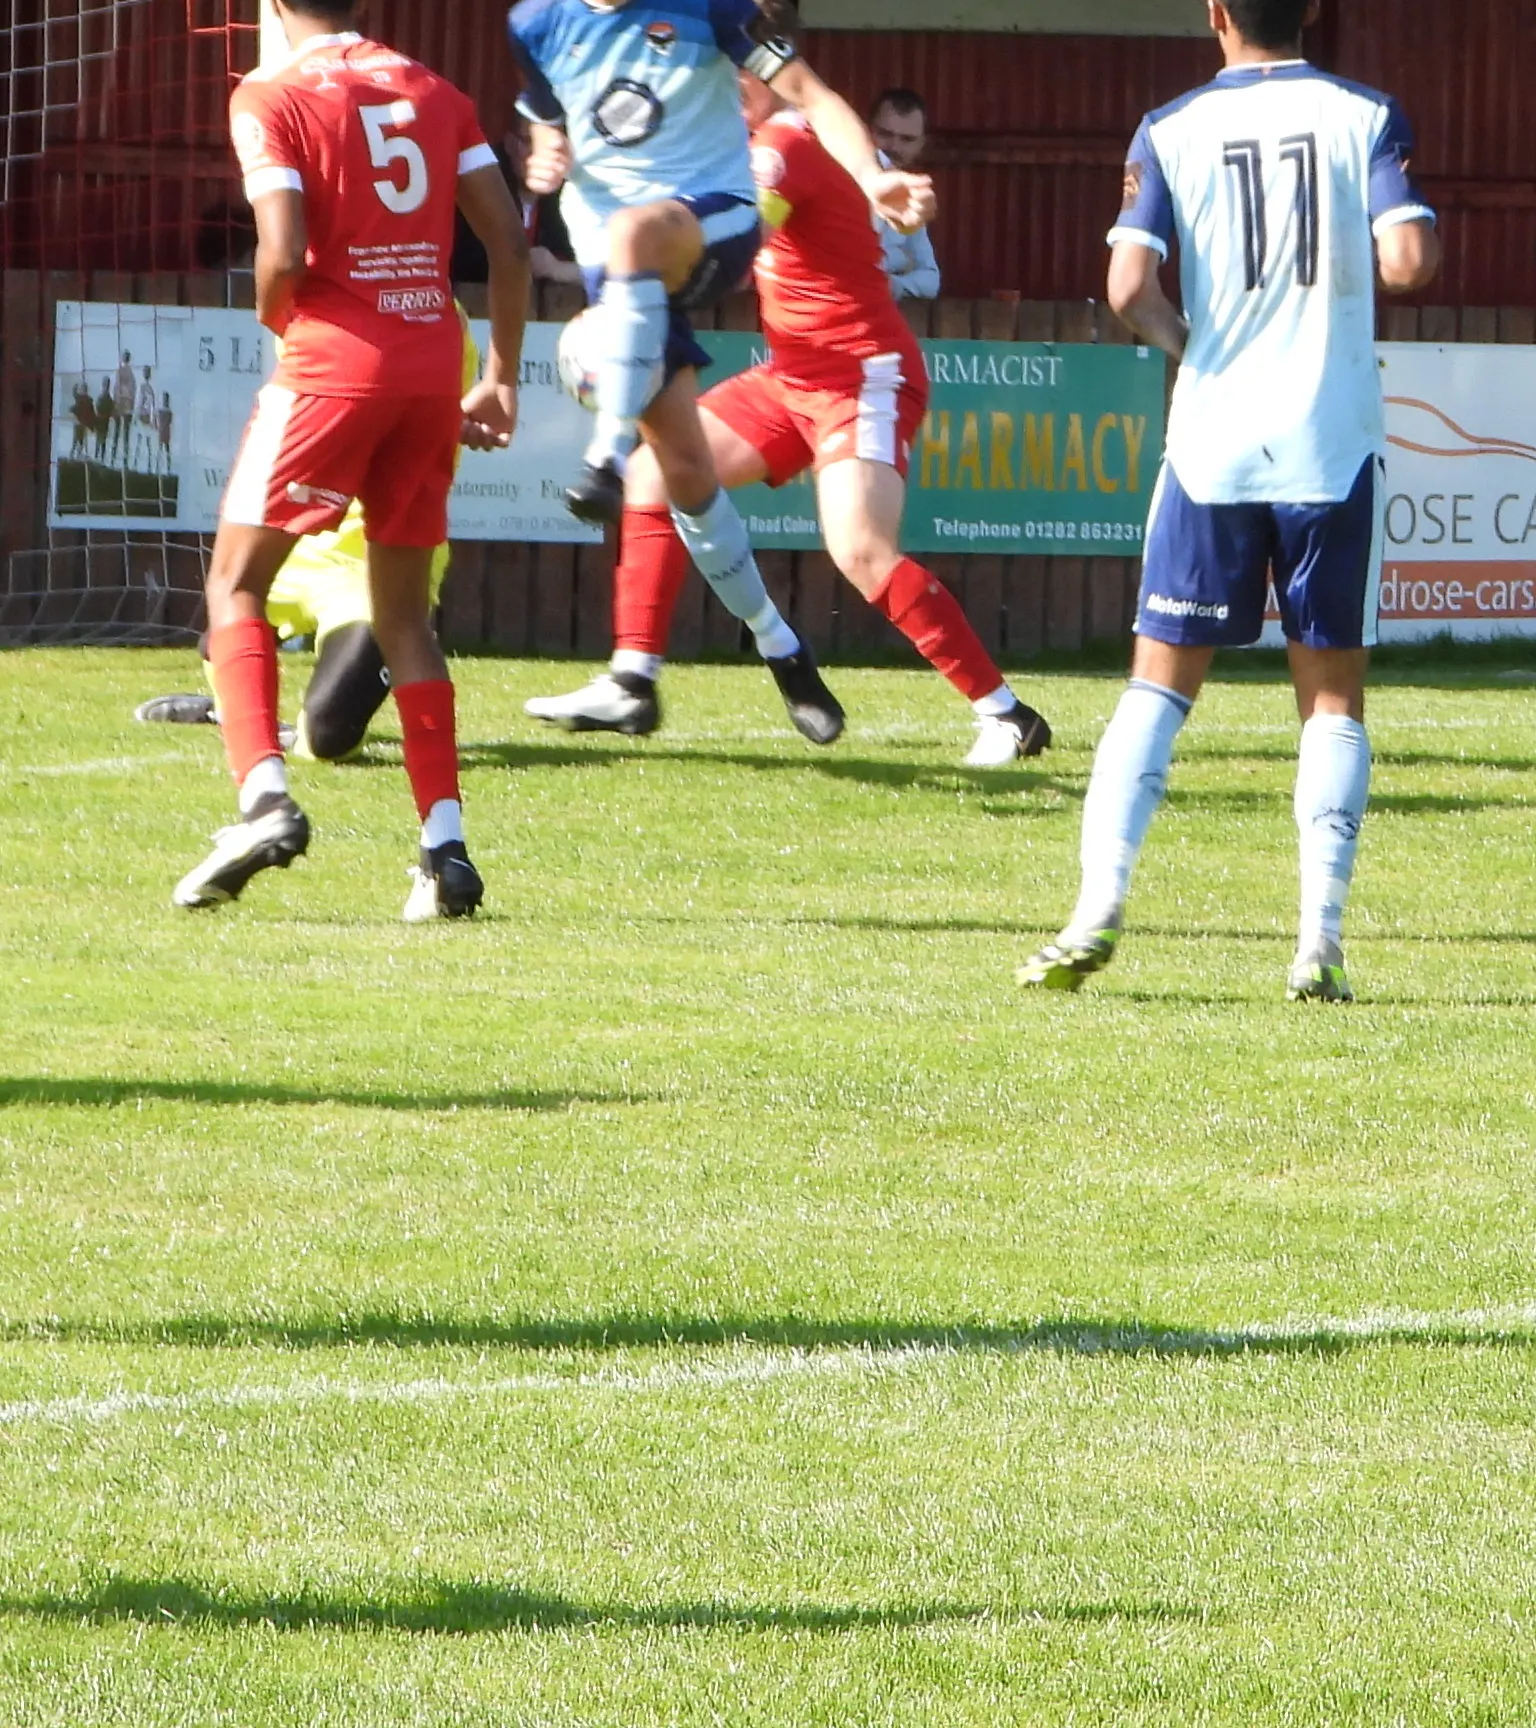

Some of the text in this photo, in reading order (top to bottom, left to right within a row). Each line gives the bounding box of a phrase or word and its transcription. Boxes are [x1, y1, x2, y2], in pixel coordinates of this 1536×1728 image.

[359, 100, 427, 213] 5
[1223, 132, 1318, 290] 11
[199, 336, 215, 373] 5
[922, 351, 1063, 387] RMACIST
[920, 410, 1146, 494] HARMACY
[453, 477, 521, 503] aternity
[933, 517, 1143, 542] Telephone 01282 863231
[1385, 493, 1473, 545] OSE
